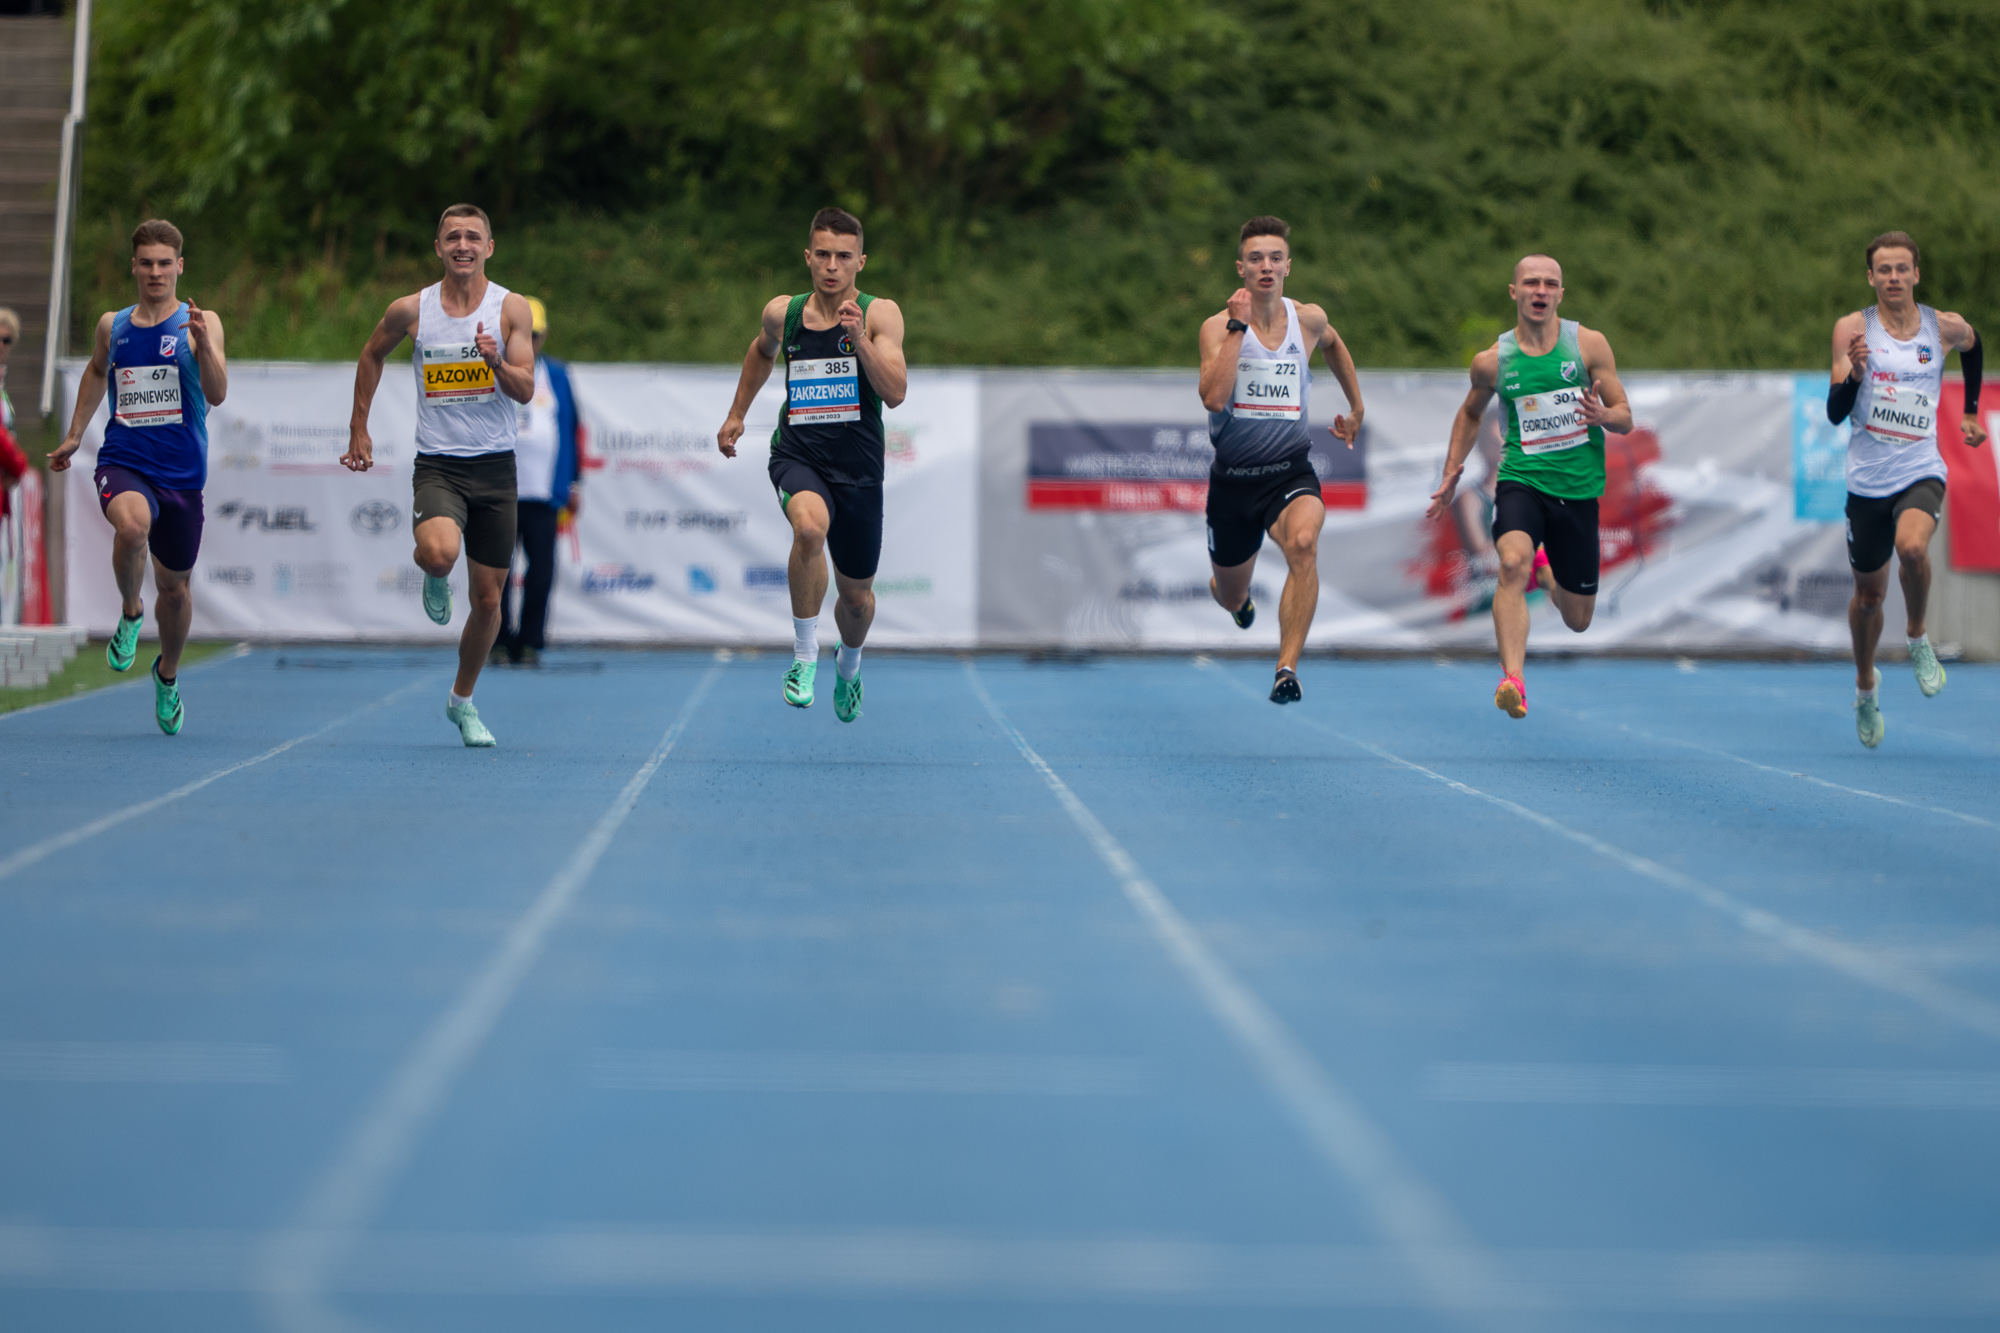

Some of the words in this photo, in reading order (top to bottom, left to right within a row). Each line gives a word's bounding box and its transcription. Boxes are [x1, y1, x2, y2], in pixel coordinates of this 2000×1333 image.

[461, 346, 484, 358] 56
[151, 368, 167, 380] 67
[825, 361, 850, 374] 385
[1275, 363, 1297, 375] 272
[427, 367, 491, 385] ŁAZOWY
[1872, 370, 1899, 382] MKL
[790, 383, 855, 402] ZAKRZEWSKI
[1246, 381, 1290, 398] ŚLIWA
[119, 389, 179, 407] SIERPNIEWSKI
[1553, 392, 1577, 405] 301
[1915, 393, 1929, 407] 78
[131, 417, 150, 425] LUBLIN
[1872, 406, 1930, 430] MINKLEJ
[1226, 466, 1261, 476] NIKE
[1262, 461, 1292, 475] PRO
